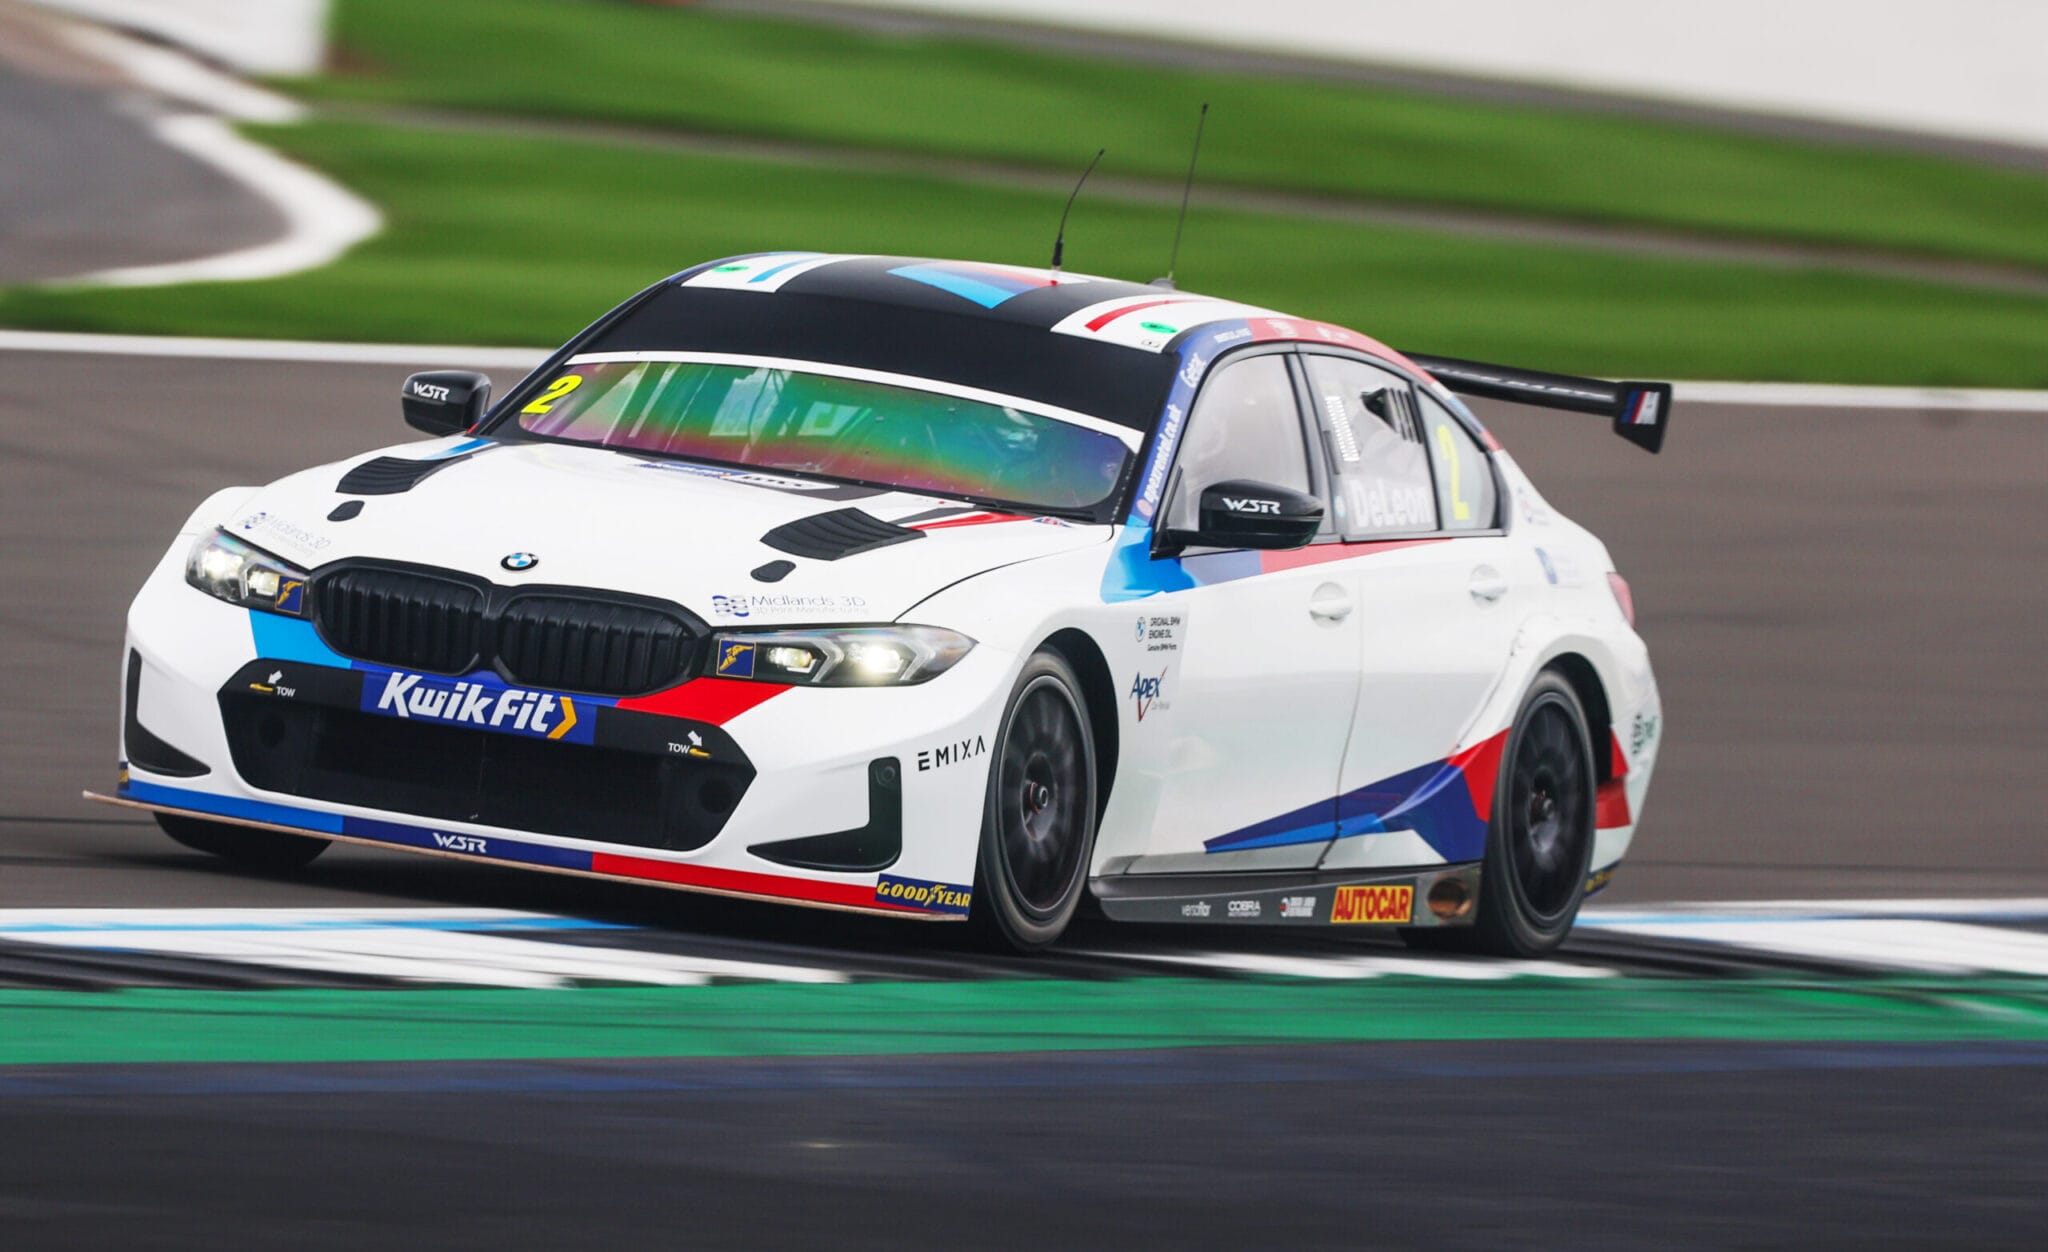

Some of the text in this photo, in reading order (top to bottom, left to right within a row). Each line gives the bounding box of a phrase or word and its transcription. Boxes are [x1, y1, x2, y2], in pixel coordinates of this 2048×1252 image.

[413, 381, 450, 401] WSR
[520, 374, 583, 414] 2
[1436, 424, 1470, 520] 2
[1222, 497, 1281, 515] WSR
[1347, 477, 1432, 528] DeLeon
[751, 594, 867, 607] Midlands 3D
[276, 686, 296, 698] TOW
[668, 741, 690, 754] TOW
[917, 735, 985, 772] EMIXA
[432, 832, 487, 854] WSR
[876, 881, 972, 907] GOODYEAR
[1333, 887, 1409, 921] AUTOCAR
